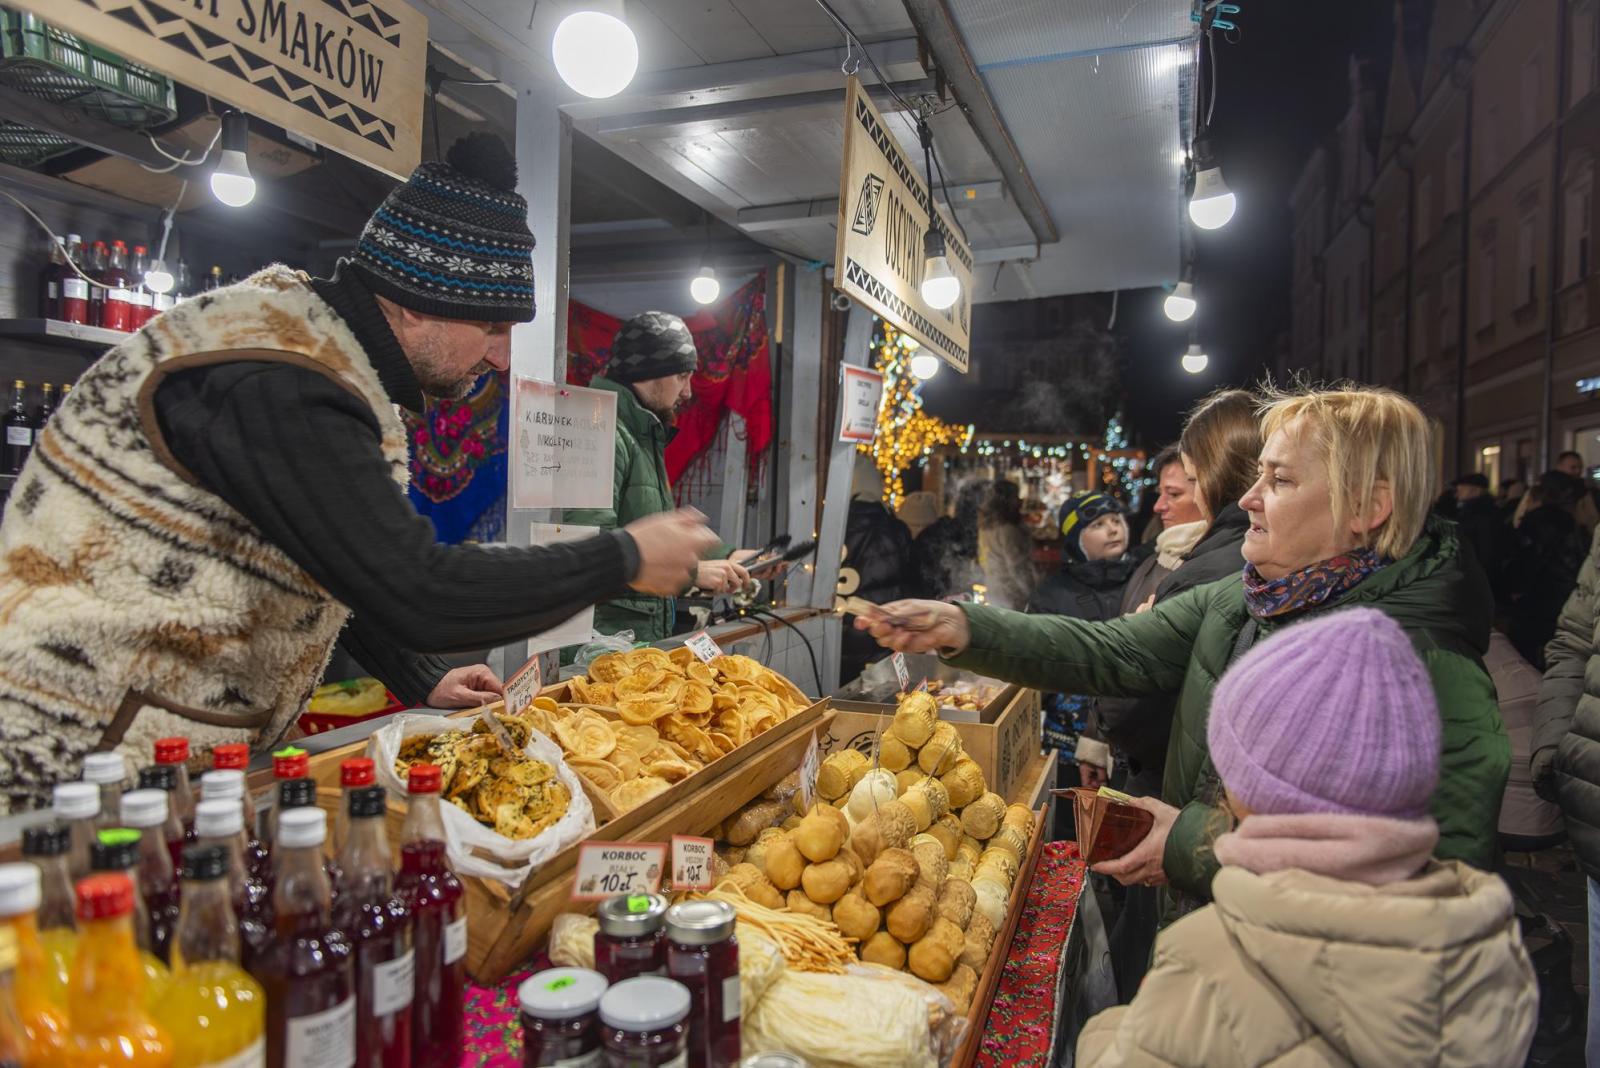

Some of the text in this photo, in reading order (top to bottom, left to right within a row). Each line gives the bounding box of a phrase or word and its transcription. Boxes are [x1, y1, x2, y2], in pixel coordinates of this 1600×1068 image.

[236, 0, 384, 103] SMAKÓW
[885, 188, 921, 293] OSCYPKI
[526, 410, 573, 426] KIERUNEK
[601, 851, 648, 861] KORBOC
[684, 843, 705, 854] KORBOC
